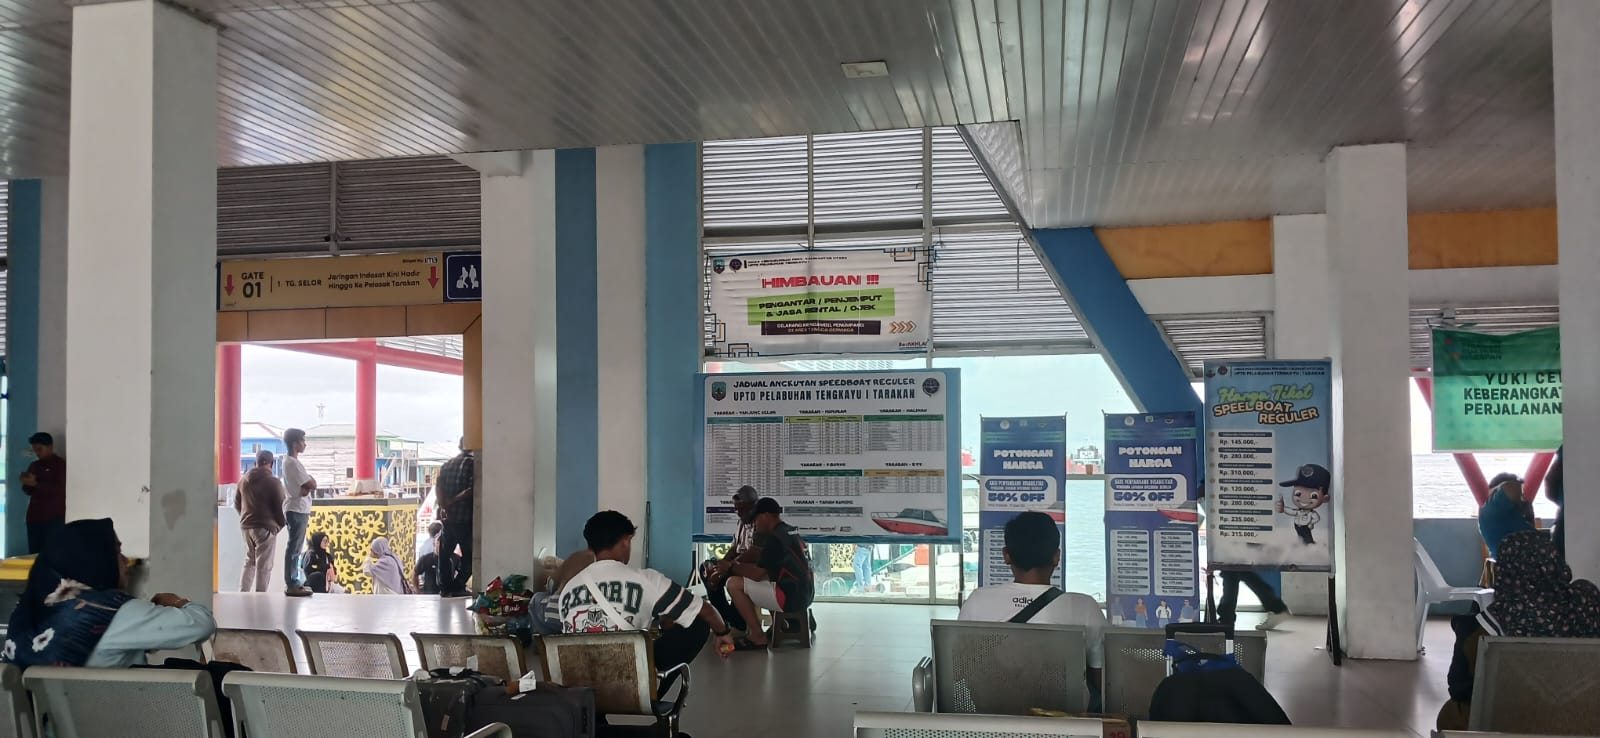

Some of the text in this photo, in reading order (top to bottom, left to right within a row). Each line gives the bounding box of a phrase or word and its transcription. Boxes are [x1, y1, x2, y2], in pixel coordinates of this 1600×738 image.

[241, 272, 265, 280] GATE
[762, 275, 862, 288] HIMBAUAN
[242, 282, 262, 298] 01
[759, 299, 816, 309] PENGANTAR
[824, 295, 882, 303] PENJEMPUT
[733, 380, 768, 388] JADWAL
[818, 379, 871, 387] SPEEDBOAT
[733, 391, 756, 401] UPTD
[760, 391, 812, 400] PELABUHAN
[816, 390, 862, 400] TENGKAYU
[873, 389, 915, 399] TARAKAN
[1218, 383, 1313, 406] Harga Tiket
[1464, 387, 1562, 400] KEBERANGKA
[1214, 401, 1292, 416] SPEEL BOAT
[1259, 408, 1318, 423] REGULER
[994, 450, 1053, 458] POTONGAN
[1118, 446, 1182, 455] POTONGAN
[1003, 461, 1044, 470] HARGA
[1129, 459, 1173, 468] HARGA
[988, 493, 1045, 502] 50% OFF
[1114, 492, 1174, 501] 50% OFF
